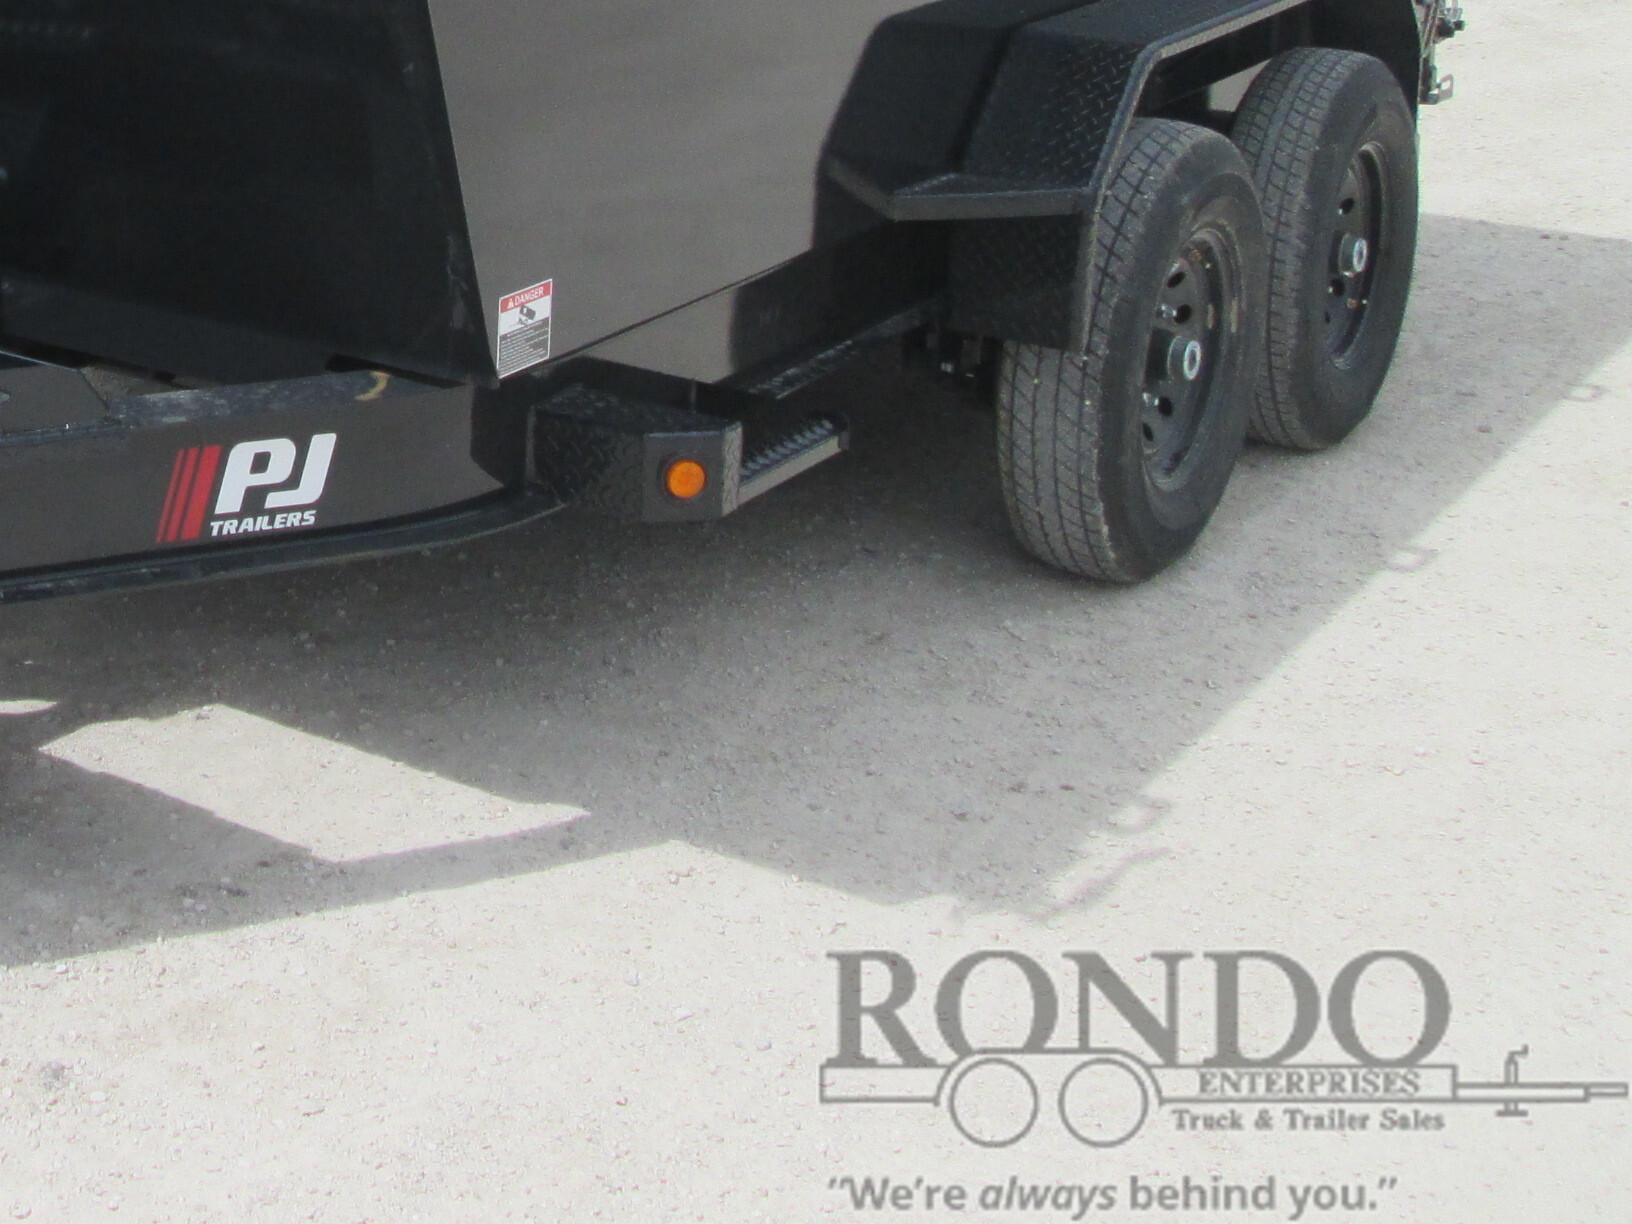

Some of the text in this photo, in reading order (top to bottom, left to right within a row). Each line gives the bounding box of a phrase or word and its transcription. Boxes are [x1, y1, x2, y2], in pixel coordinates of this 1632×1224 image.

[514, 286, 544, 307] DANGER
[214, 432, 337, 515] PJ
[210, 510, 317, 537] TRAILERS
